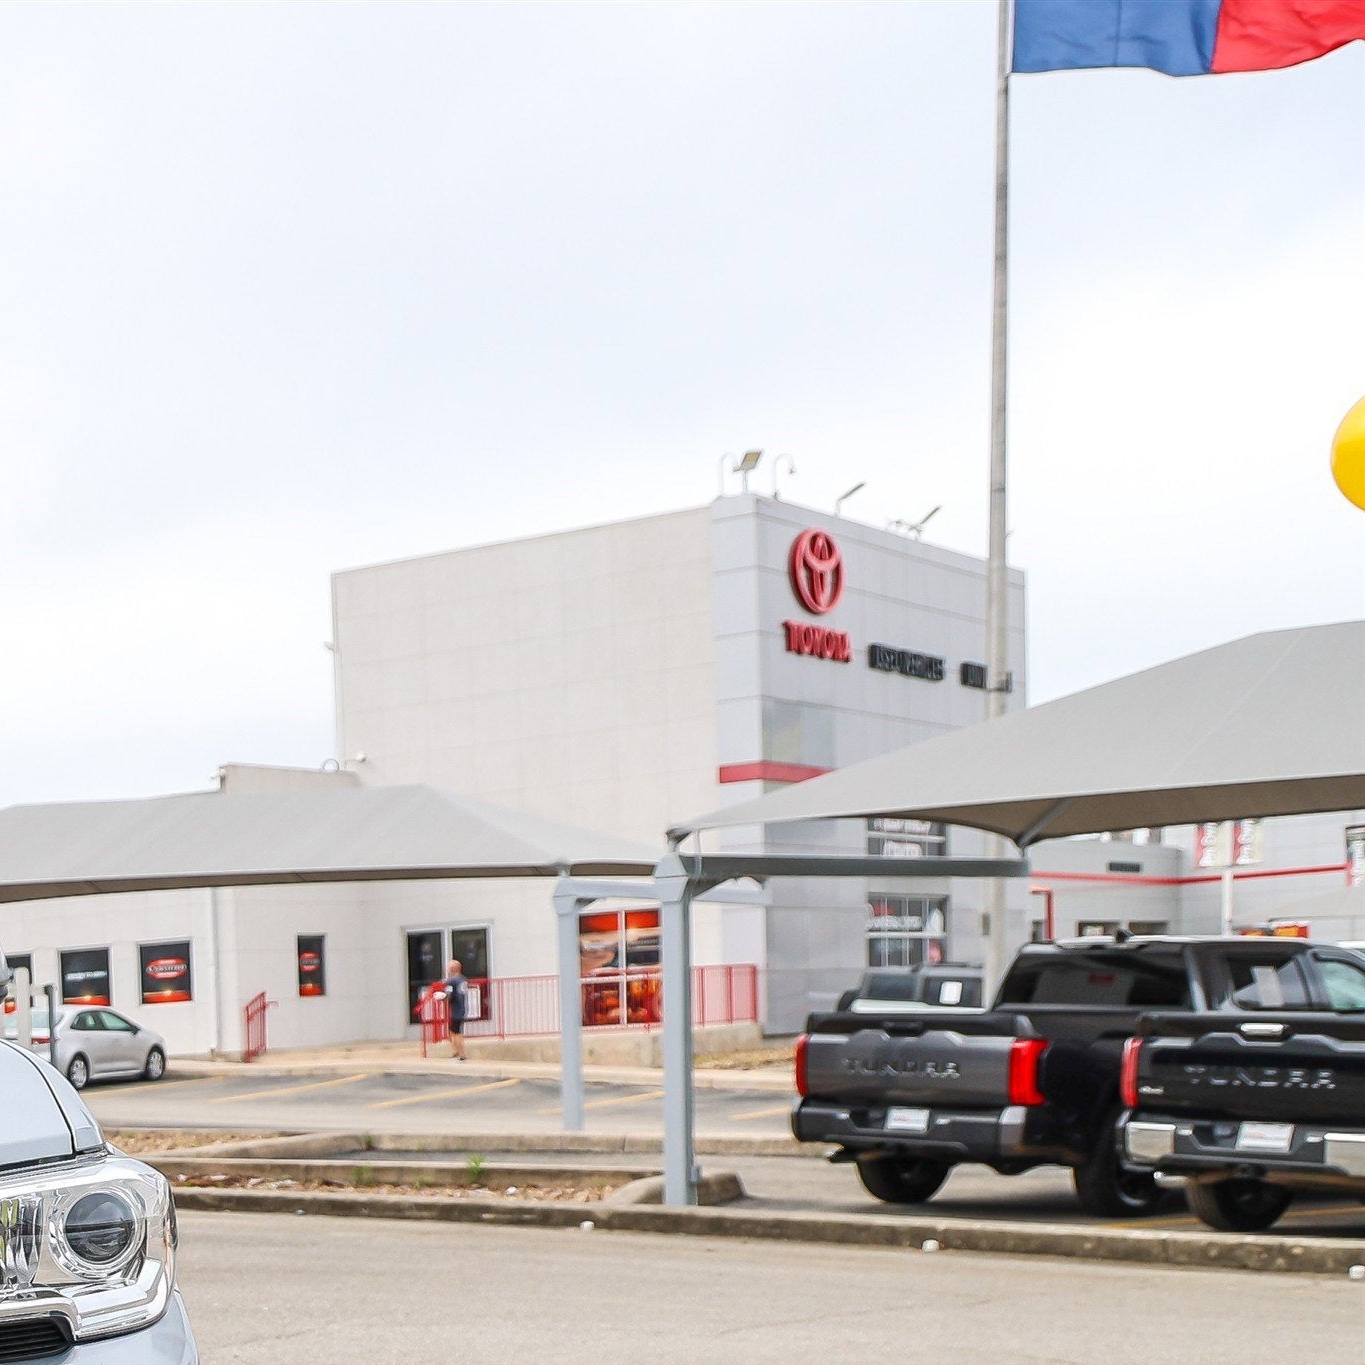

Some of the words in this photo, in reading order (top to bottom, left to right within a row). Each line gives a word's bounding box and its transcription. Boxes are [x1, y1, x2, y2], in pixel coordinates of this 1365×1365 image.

[782, 619, 852, 663] TOYOTA
[841, 1057, 960, 1078] TUNDRA
[1183, 1064, 1337, 1089] TUNDRA
